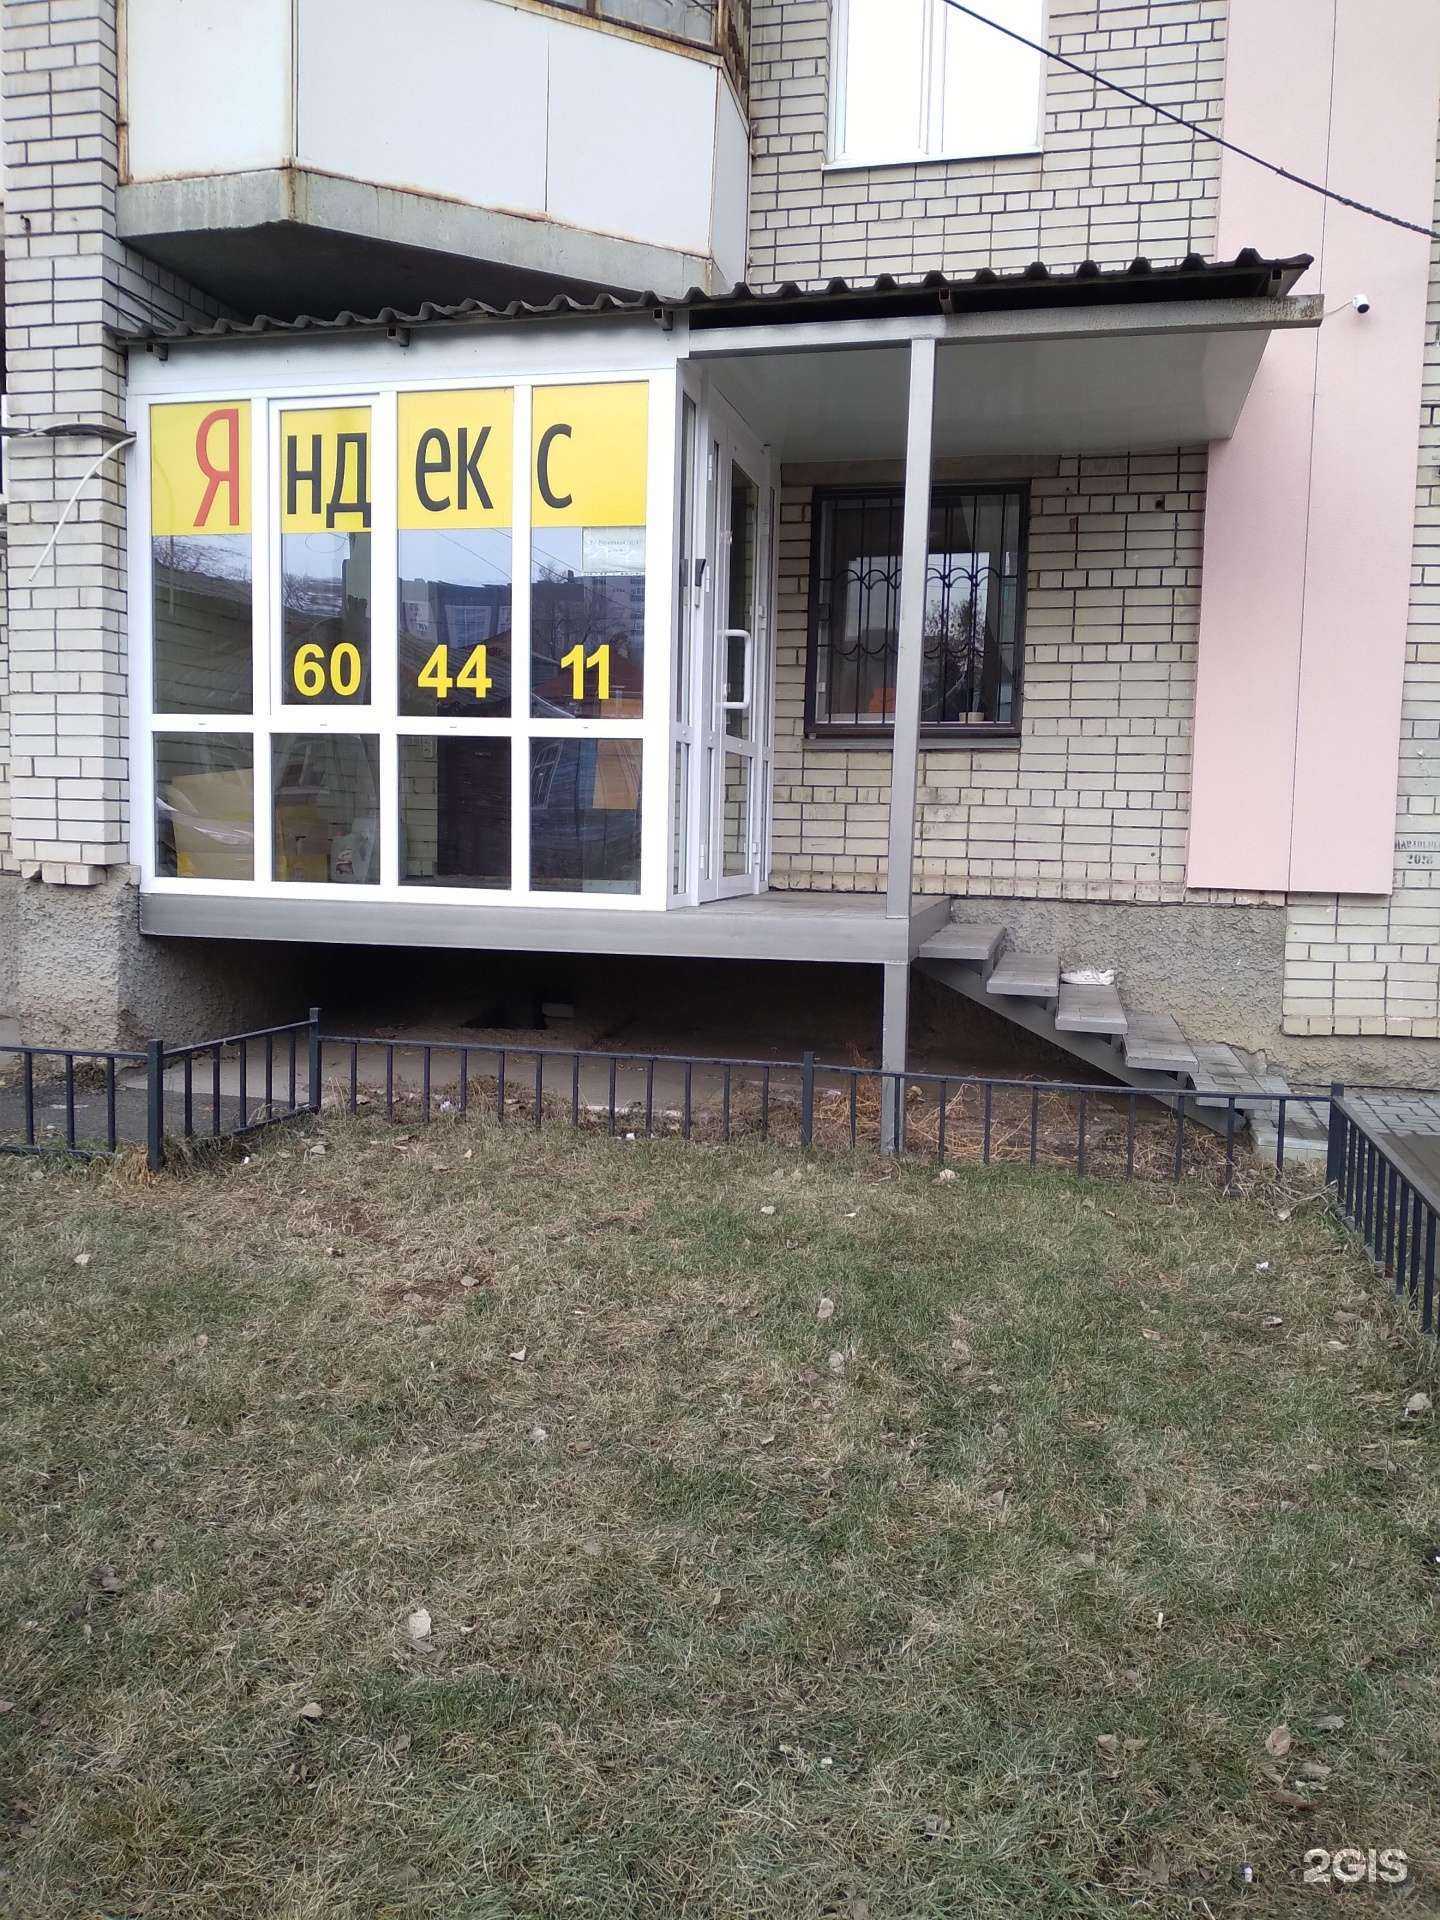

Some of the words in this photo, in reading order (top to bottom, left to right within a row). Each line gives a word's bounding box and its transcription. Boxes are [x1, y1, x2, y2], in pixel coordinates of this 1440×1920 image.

[293, 642, 361, 697] 60
[417, 644, 493, 699] 44
[560, 644, 610, 700] 11
